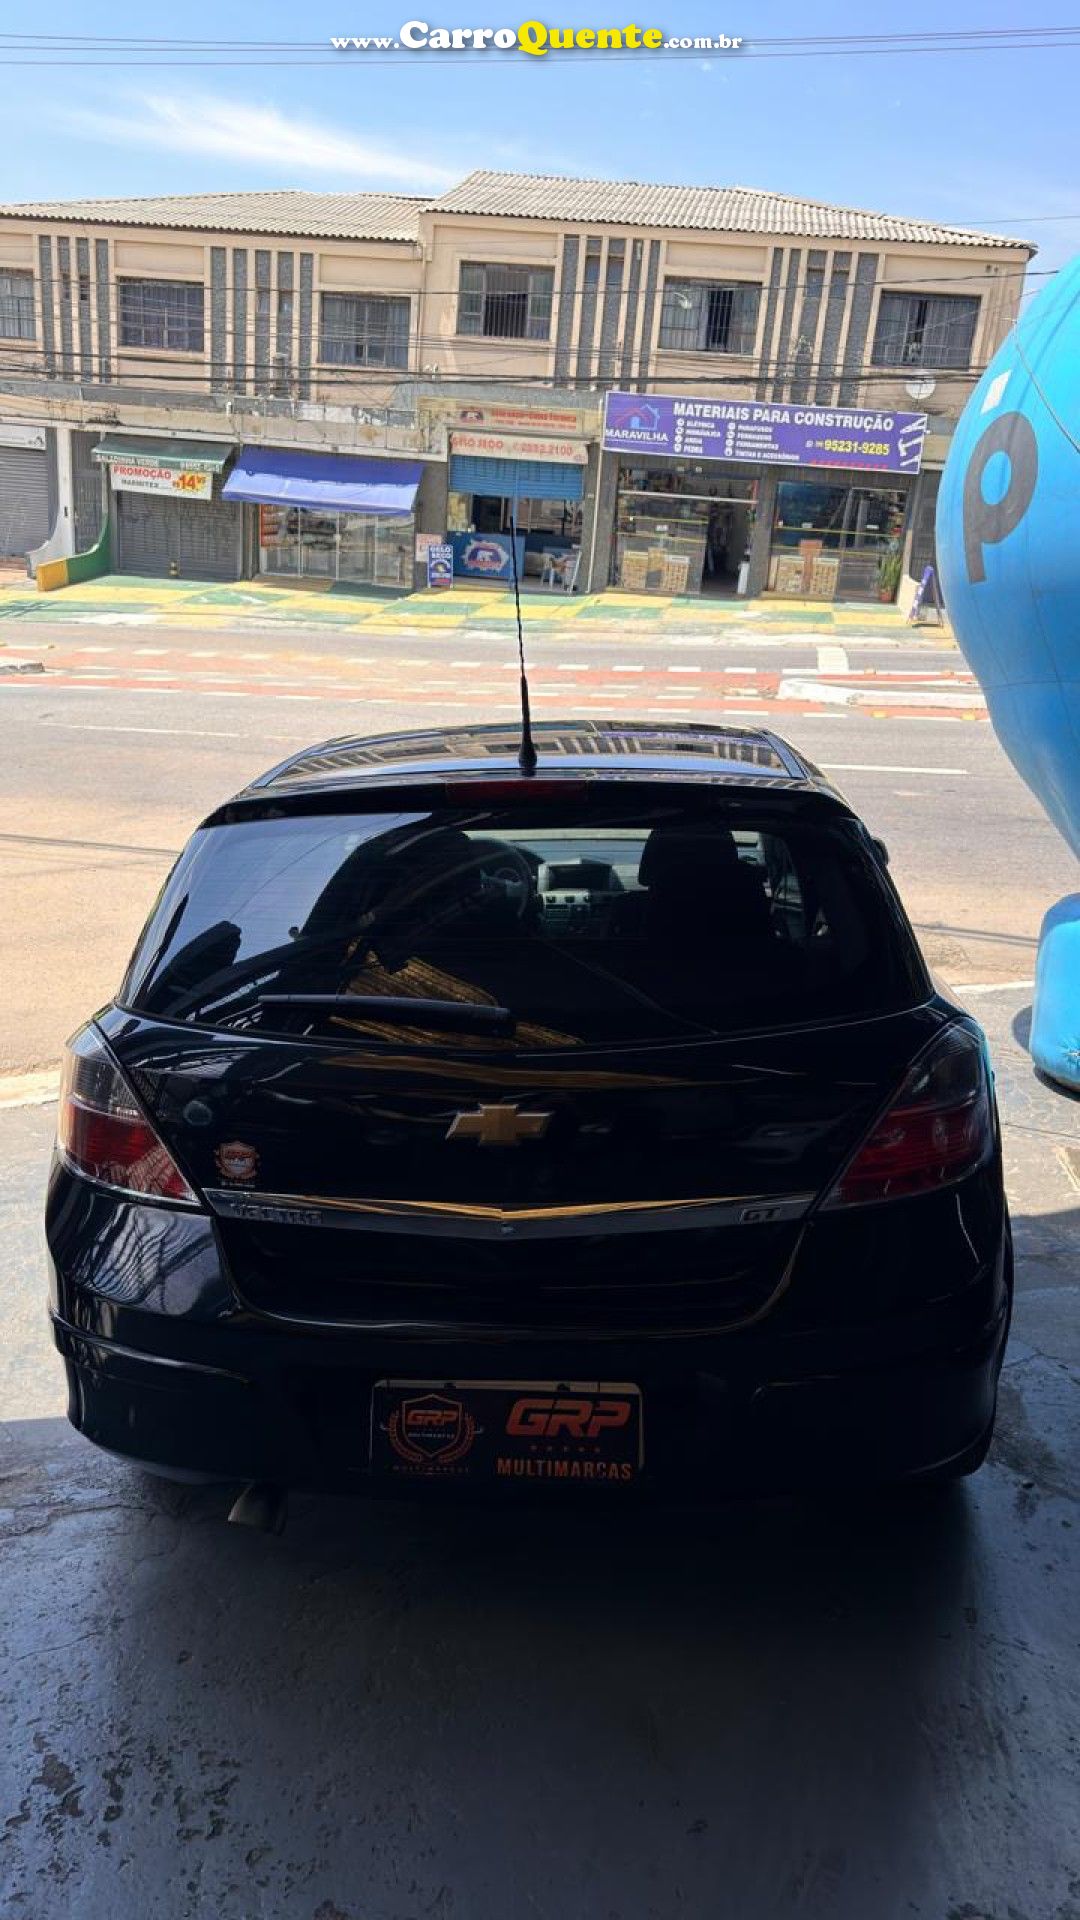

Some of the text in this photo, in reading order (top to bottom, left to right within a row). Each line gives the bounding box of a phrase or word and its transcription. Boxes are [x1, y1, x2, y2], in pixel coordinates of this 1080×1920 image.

[673, 402, 894, 432] MATERIAIS PARA CONSTRUÇÃO
[605, 428, 669, 442] MARAVILHA
[113, 465, 172, 479] PROMOÇÃO
[407, 1409, 459, 1426] GRP
[505, 1397, 632, 1438] GRP
[496, 1456, 633, 1481] MULTIMARCAS
